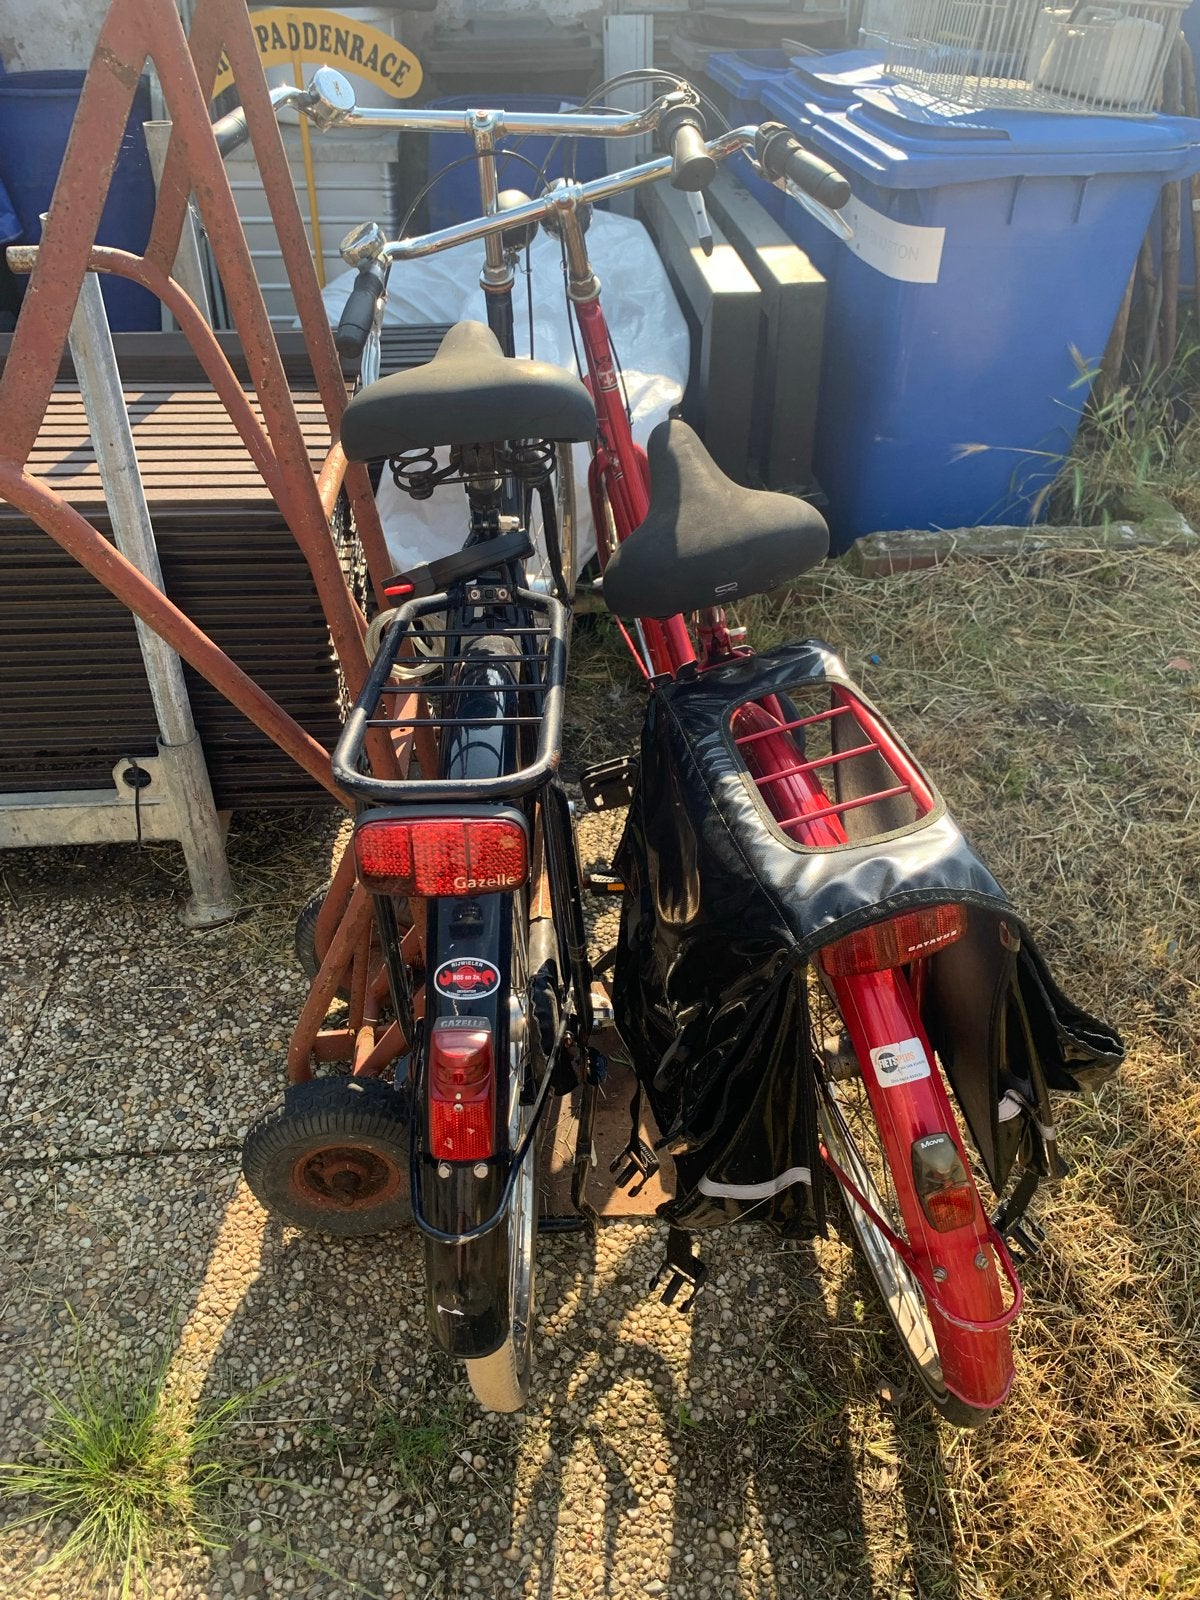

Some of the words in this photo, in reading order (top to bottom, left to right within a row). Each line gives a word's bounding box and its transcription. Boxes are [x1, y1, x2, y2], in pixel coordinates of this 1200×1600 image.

[254, 21, 411, 88] PADDENRACE
[454, 873, 517, 889] Gazelle
[907, 929, 957, 952] BATAVUS
[441, 1019, 486, 1028] GAZELLE
[920, 1138, 945, 1149] Move
